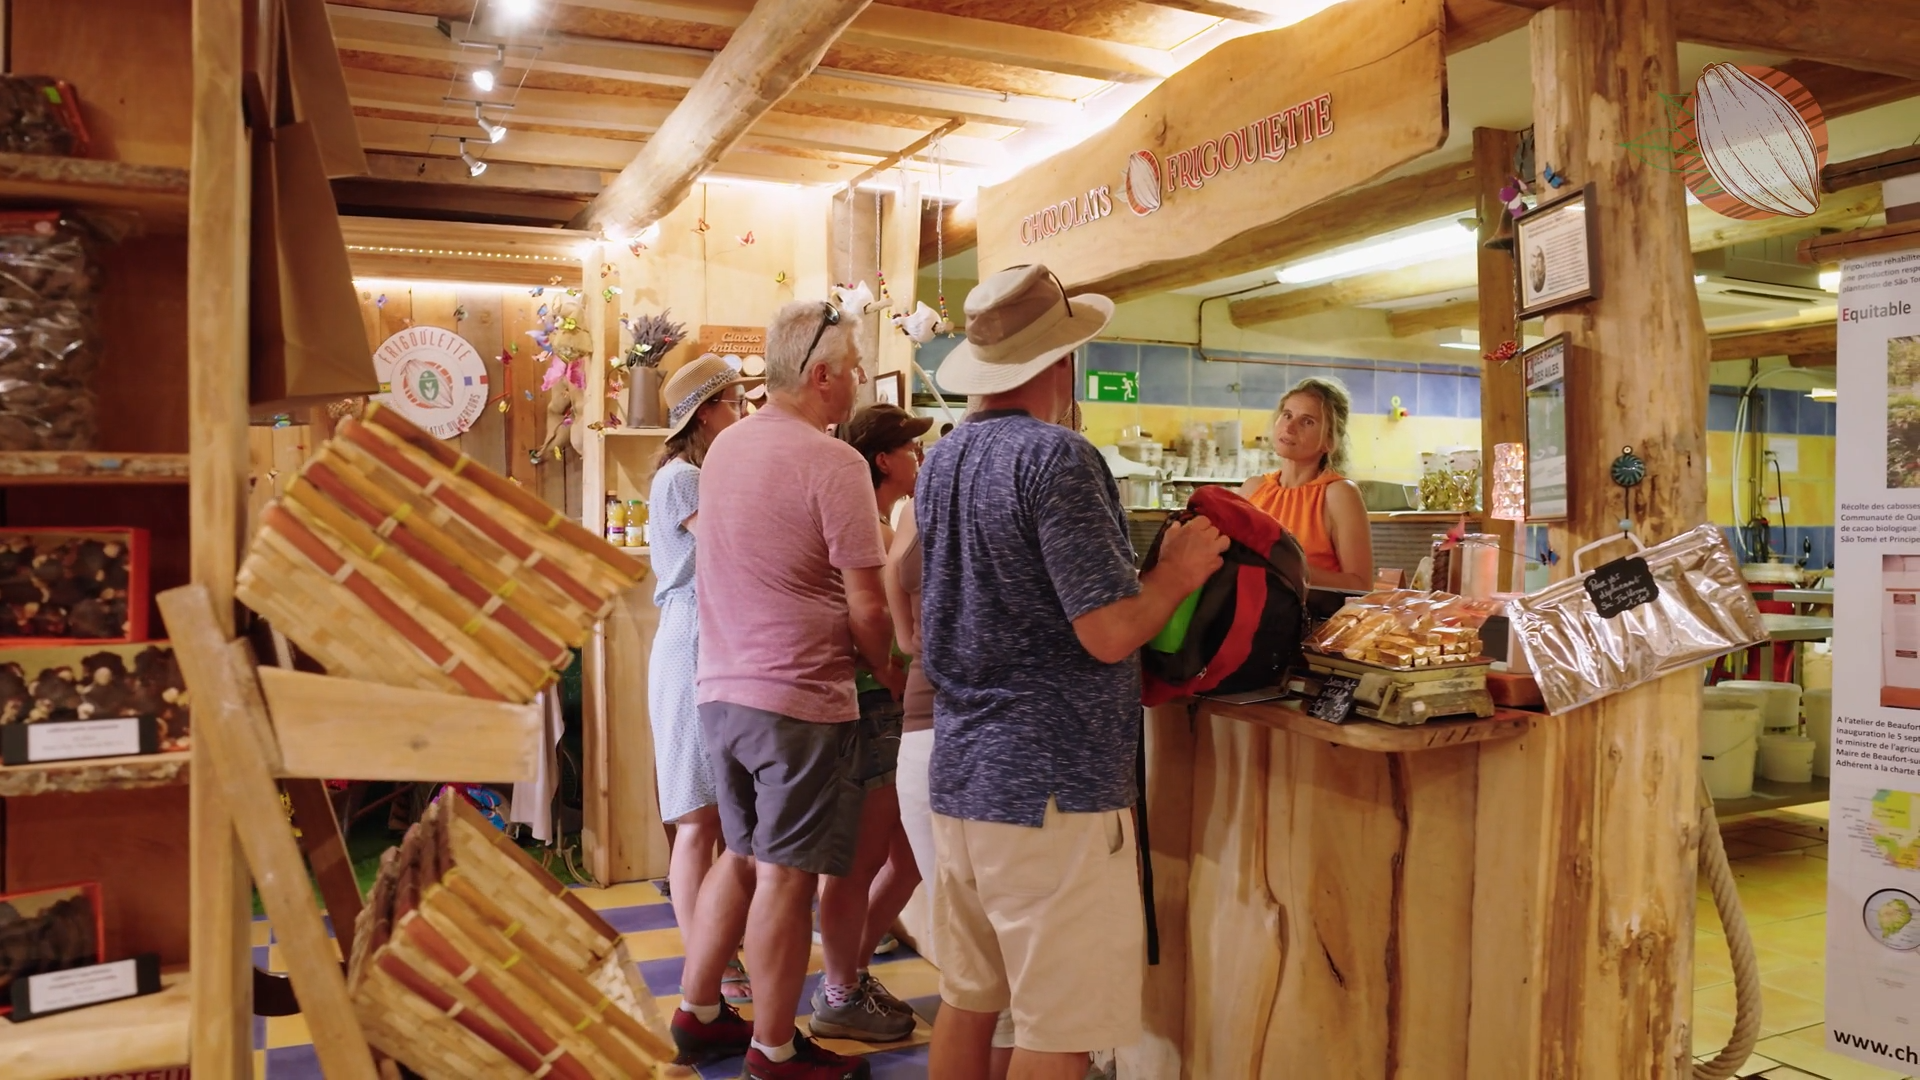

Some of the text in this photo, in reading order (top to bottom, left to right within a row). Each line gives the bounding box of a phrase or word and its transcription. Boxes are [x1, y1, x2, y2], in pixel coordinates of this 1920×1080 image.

[1165, 91, 1334, 193] FRIGOULETTE
[1857, 269, 1900, 281] production
[1842, 283, 1881, 294] plantation
[1842, 300, 1912, 324] Equitable
[1876, 525, 1917, 533] biologique
[1840, 535, 1855, 543] São
[1857, 535, 1878, 543] Tomé
[1844, 716, 1874, 726] l'atelier
[1836, 727, 1886, 738] inauguration
[1836, 737, 1844, 745] le
[1845, 739, 1877, 748] ministre
[1890, 743, 1920, 753] l'agricu
[1836, 748, 1859, 757] Maire
[1860, 751, 1871, 759] de
[1836, 759, 1872, 770] Adhérent
[1880, 764, 1888, 772] la
[1889, 766, 1916, 776] charte
[1833, 1029, 1918, 1065] www.ch
